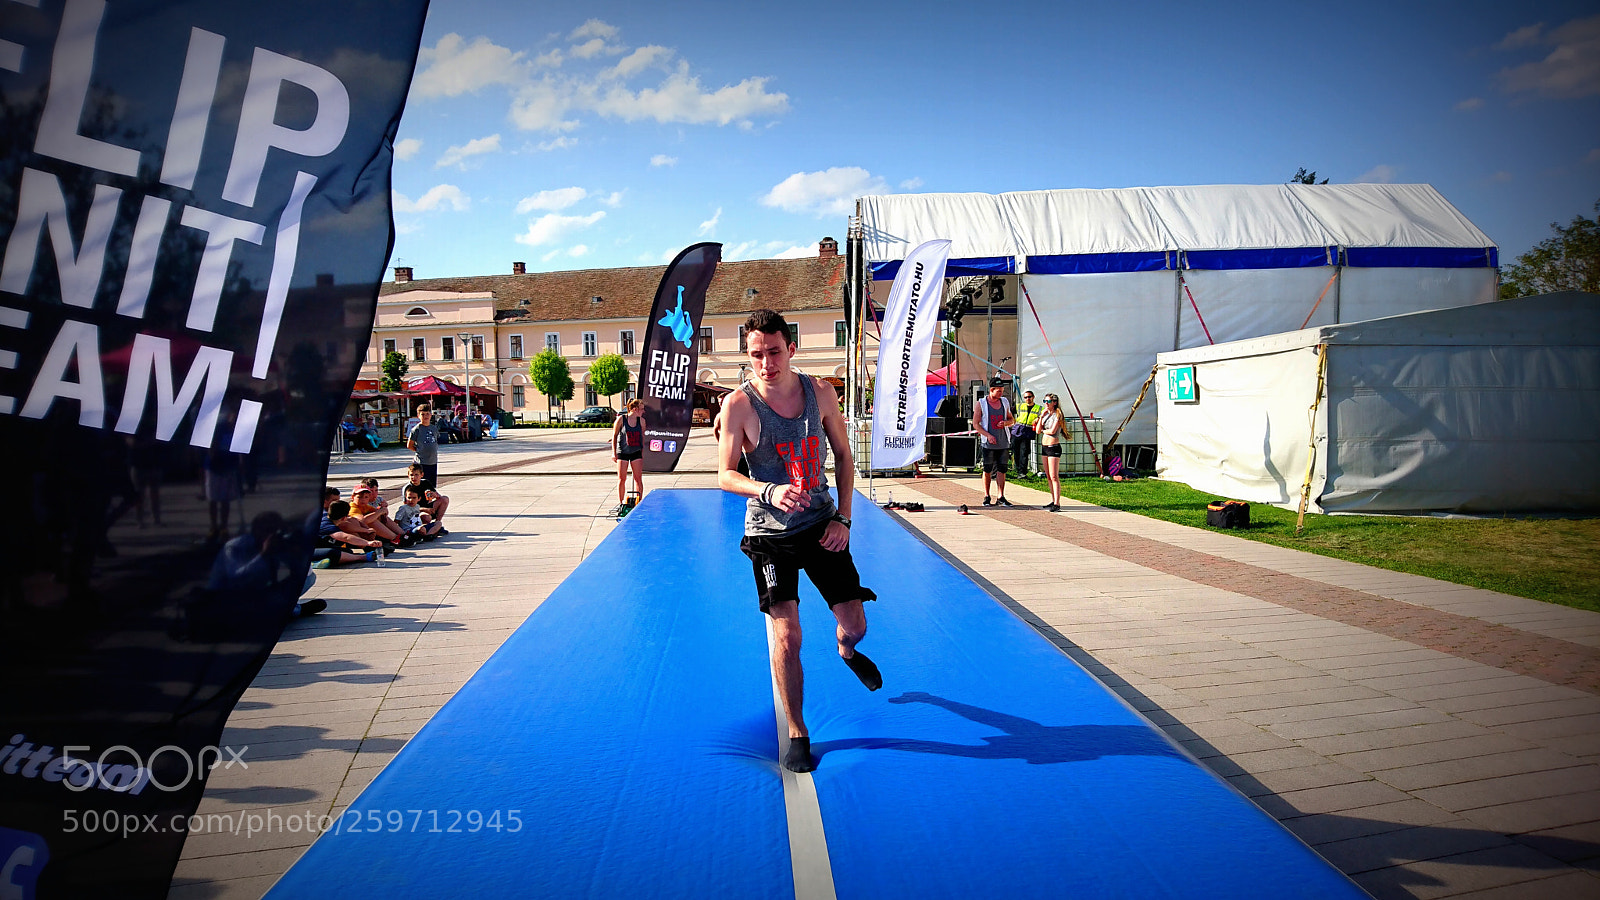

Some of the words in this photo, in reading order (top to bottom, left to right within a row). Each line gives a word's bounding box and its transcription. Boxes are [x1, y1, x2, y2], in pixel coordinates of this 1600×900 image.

[0, 0, 350, 207] LIP
[650, 350, 691, 373] FLIP
[897, 262, 924, 431] EXTREMSPORTBEMUTATO.HU
[775, 436, 820, 462] FLIP
